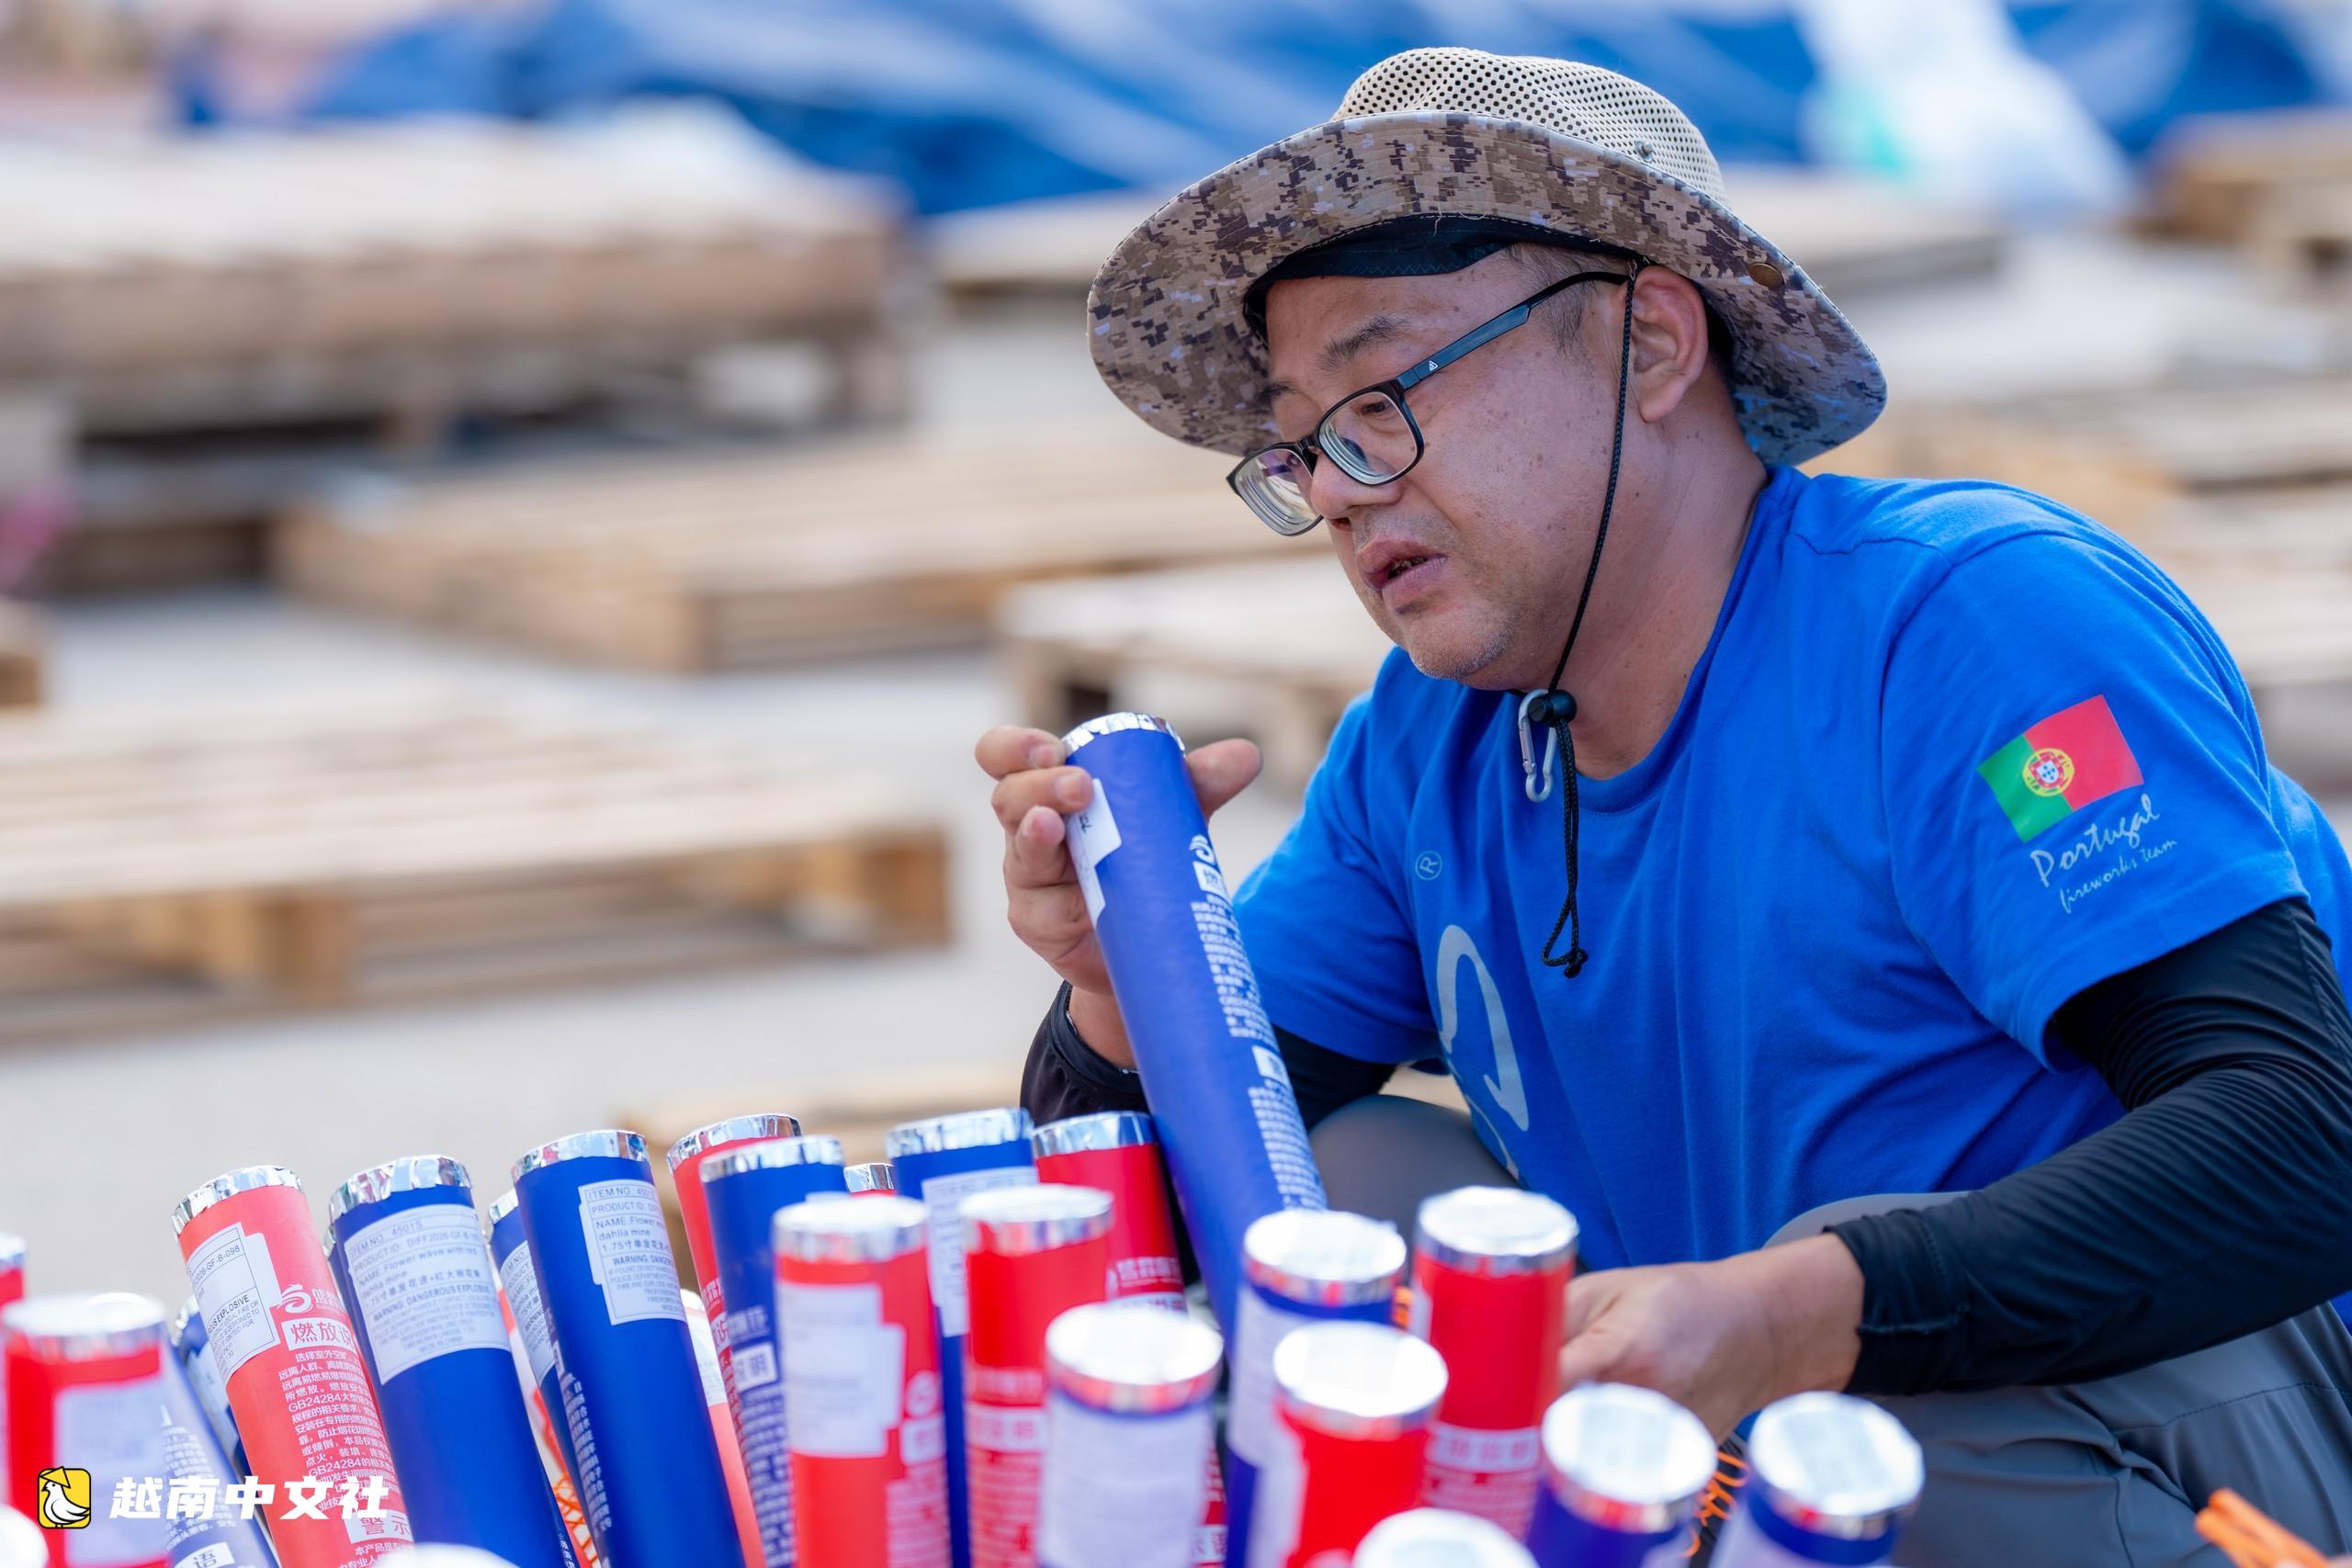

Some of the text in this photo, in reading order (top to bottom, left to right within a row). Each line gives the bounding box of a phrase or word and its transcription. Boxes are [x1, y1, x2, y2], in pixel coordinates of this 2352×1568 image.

[2030, 793, 2160, 888] Portugal
[2060, 840, 2178, 914] fireworks team
[391, 1221, 423, 1235] 4501S
[217, 1294, 250, 1324] EXPLOSIVE
[406, 1288, 457, 1306] DANGEROUS
